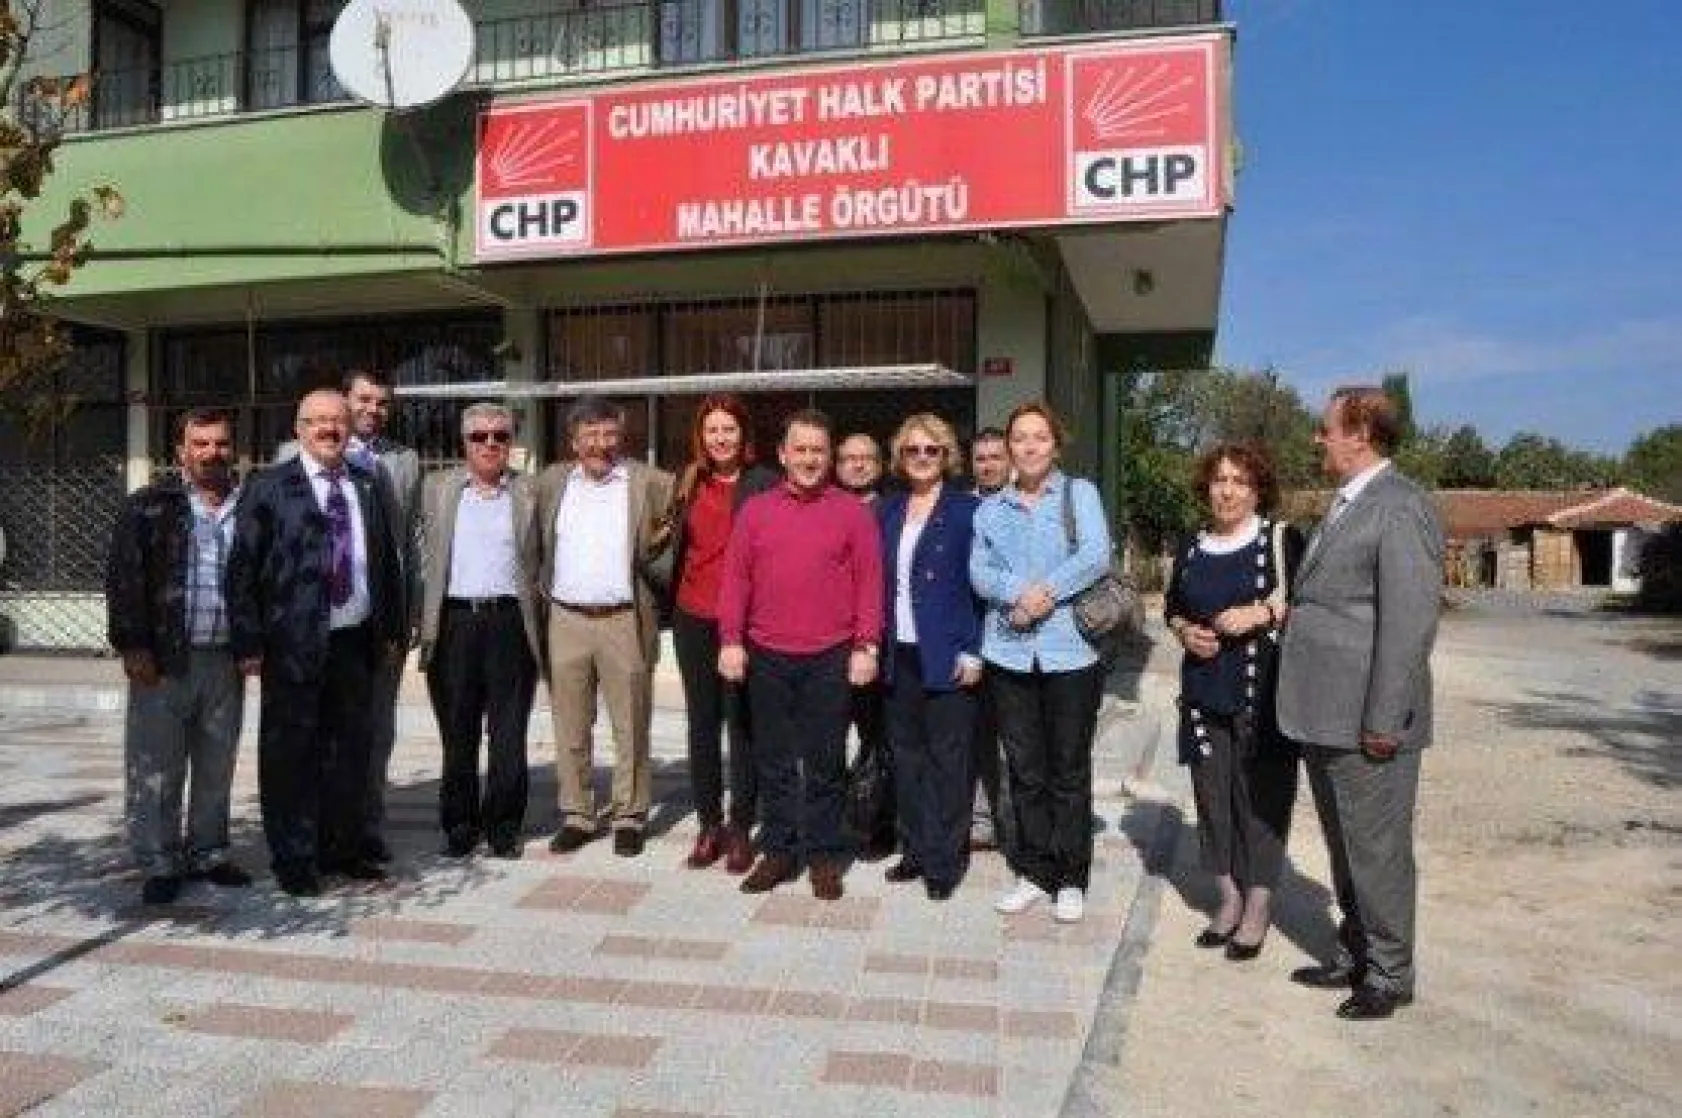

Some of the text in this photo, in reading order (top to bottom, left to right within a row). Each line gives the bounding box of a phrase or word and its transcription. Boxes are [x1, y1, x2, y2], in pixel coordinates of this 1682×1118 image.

[608, 58, 1047, 139] CUMHURİYET HALK PARTİSİ
[750, 133, 890, 179] KAVAKLI
[1084, 154, 1196, 198] CHP
[490, 199, 578, 240] CHP
[677, 175, 969, 238] MAHALLE ÖRGÜTÜ
